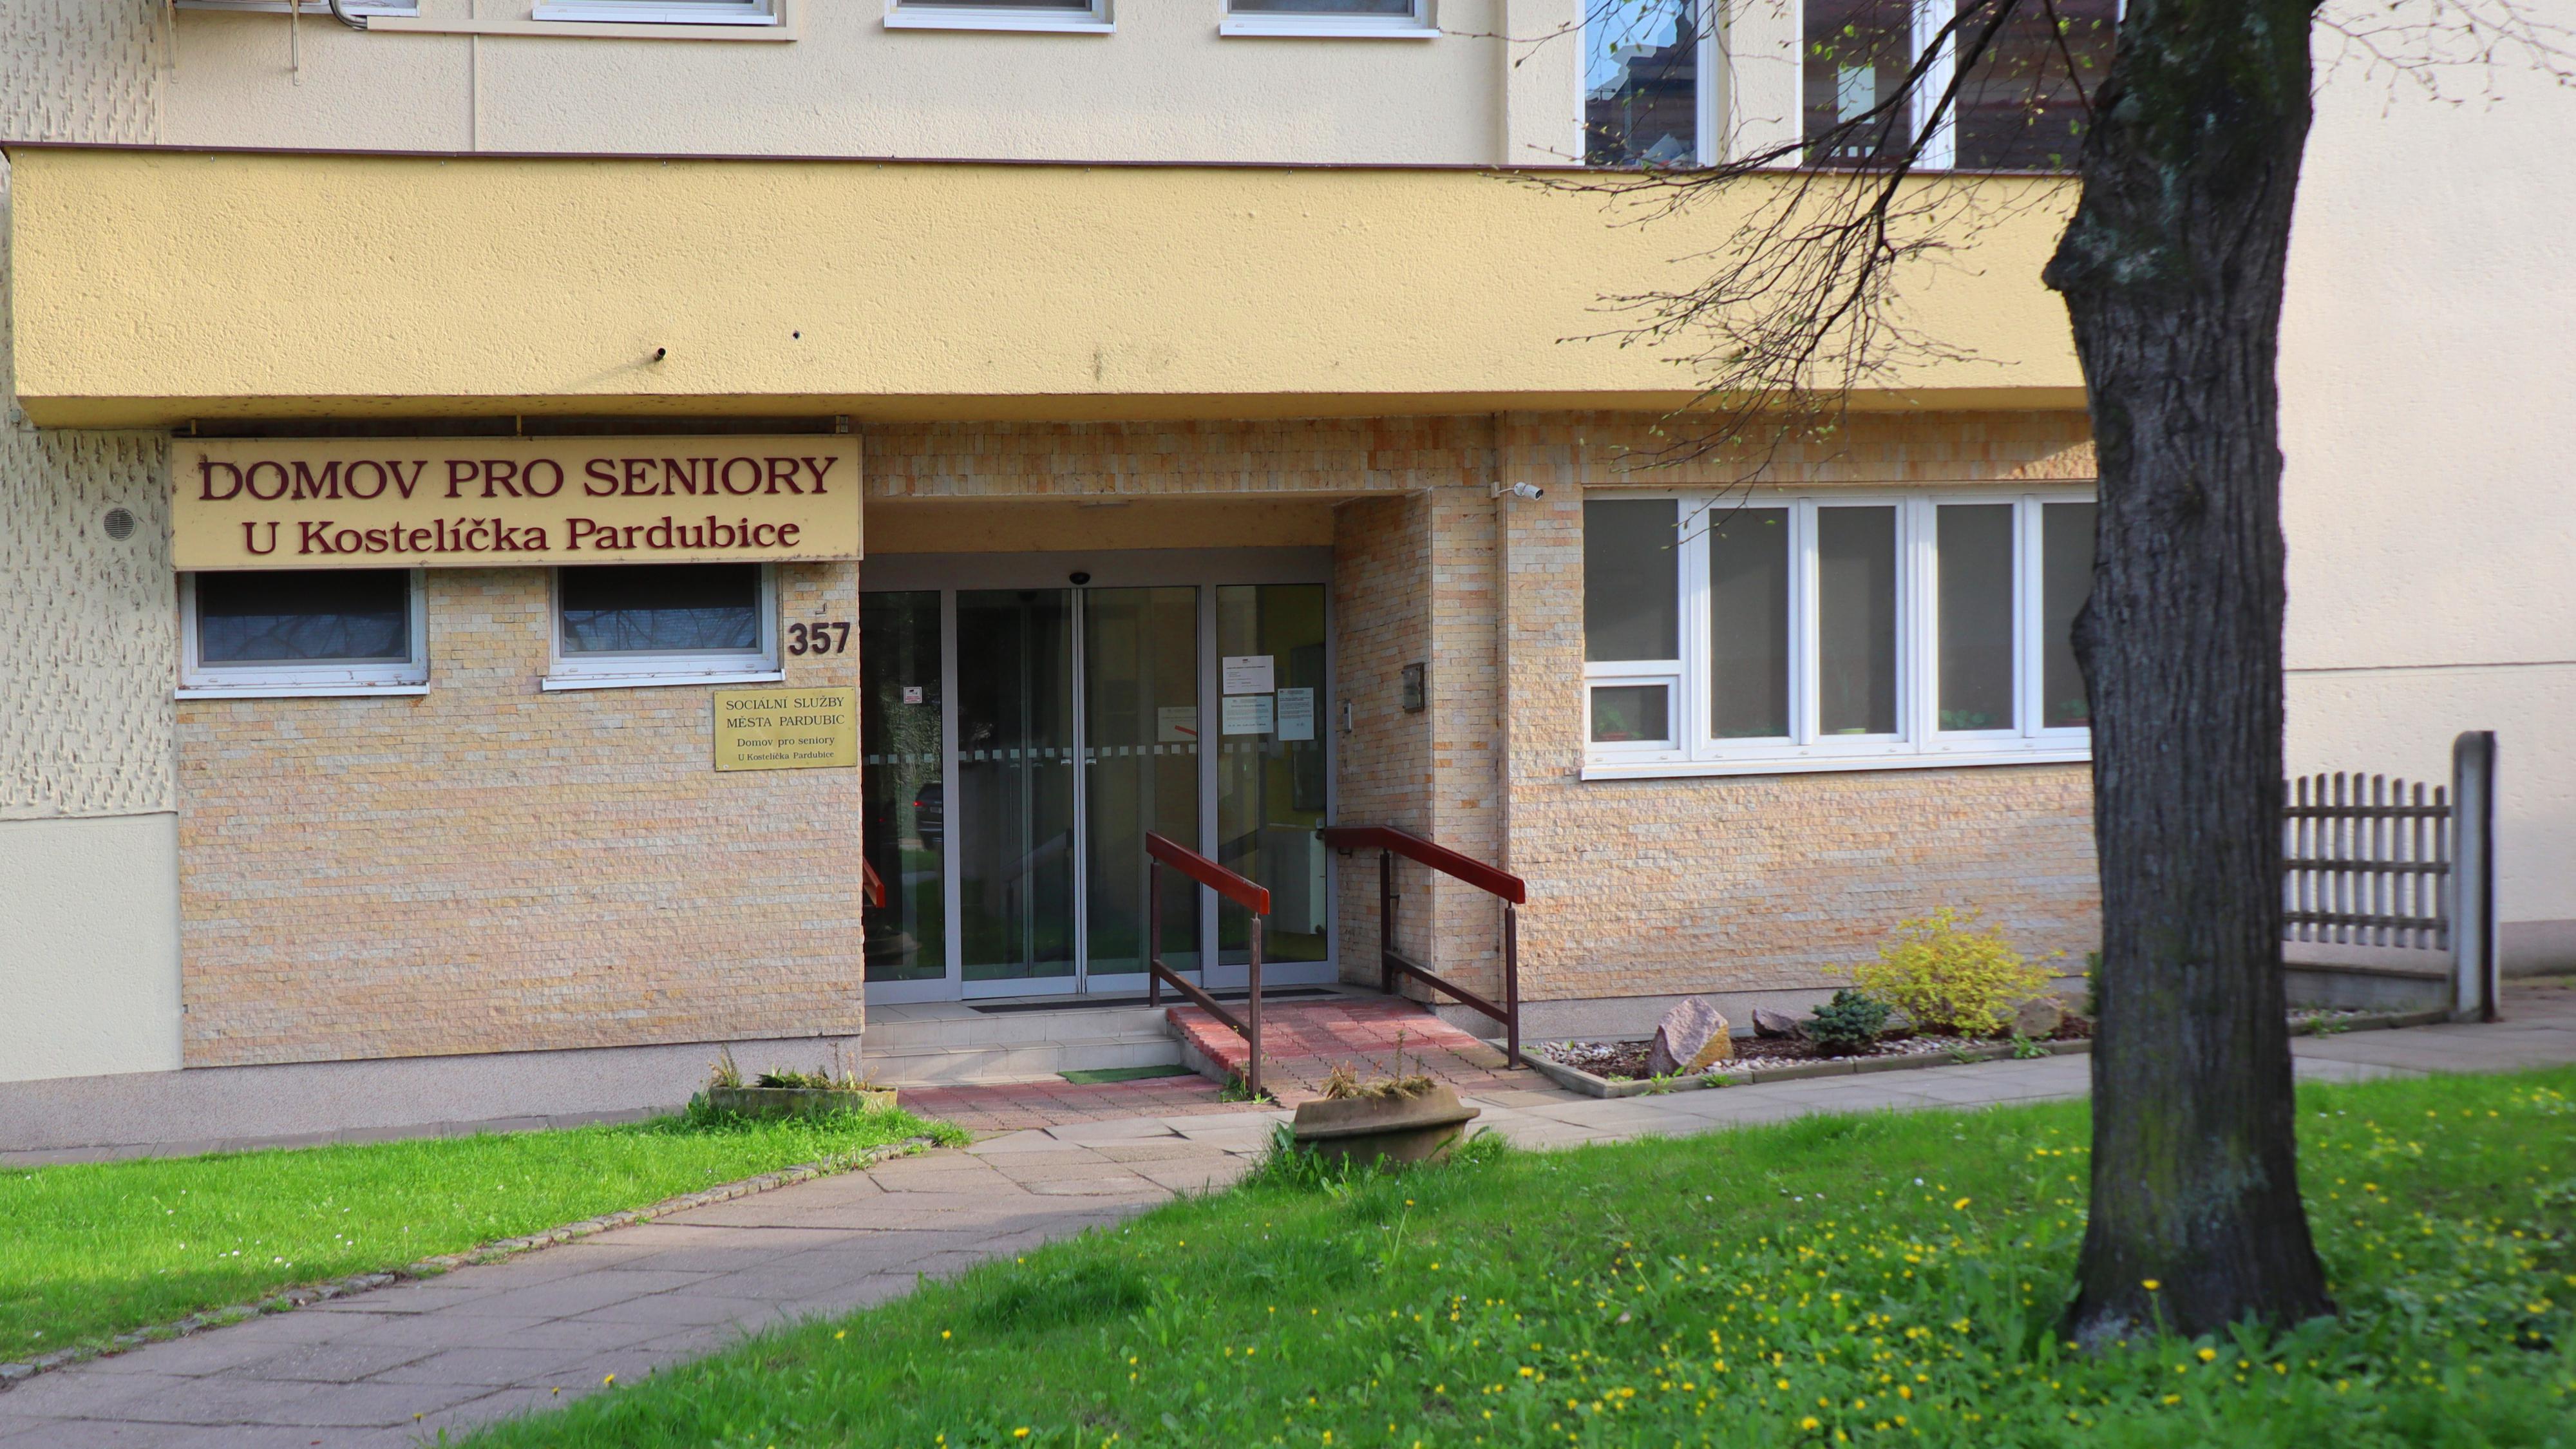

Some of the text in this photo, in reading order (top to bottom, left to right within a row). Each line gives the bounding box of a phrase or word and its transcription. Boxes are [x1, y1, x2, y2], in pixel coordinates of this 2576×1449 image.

[198, 456, 838, 500] DOMOV PRO SENIORY
[242, 515, 800, 555] U Kostelíčka Pardubice
[789, 621, 851, 656] 357
[726, 695, 844, 710] SOCIÁLNÍ SLUŽBY
[726, 714, 845, 728] MĚSTA PARDUBIC
[737, 736, 835, 748] Domov pro seniory
[747, 752, 790, 761] Kostelíčka
[793, 751, 834, 759] Pardubice
